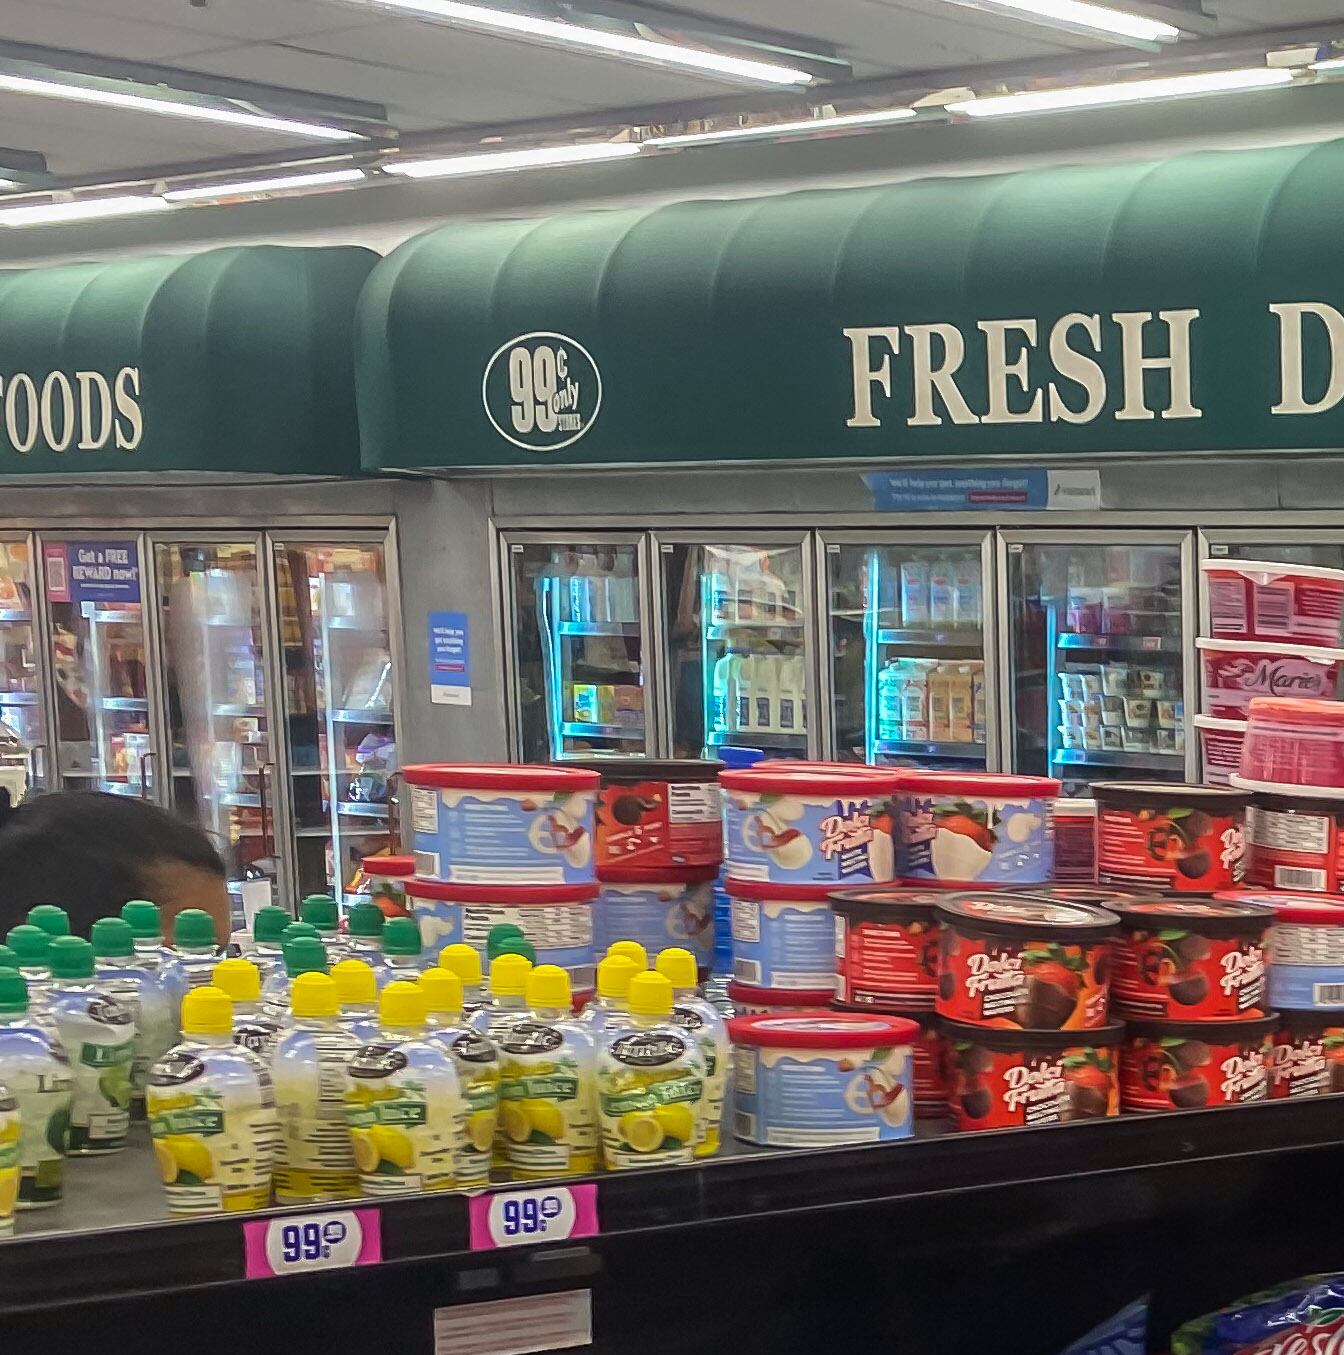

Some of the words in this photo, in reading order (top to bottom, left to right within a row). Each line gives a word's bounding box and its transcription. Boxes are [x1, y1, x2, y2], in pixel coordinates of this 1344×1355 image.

[0, 366, 143, 453] OODS
[552, 377, 579, 413] only
[843, 308, 1202, 428] FRESH
